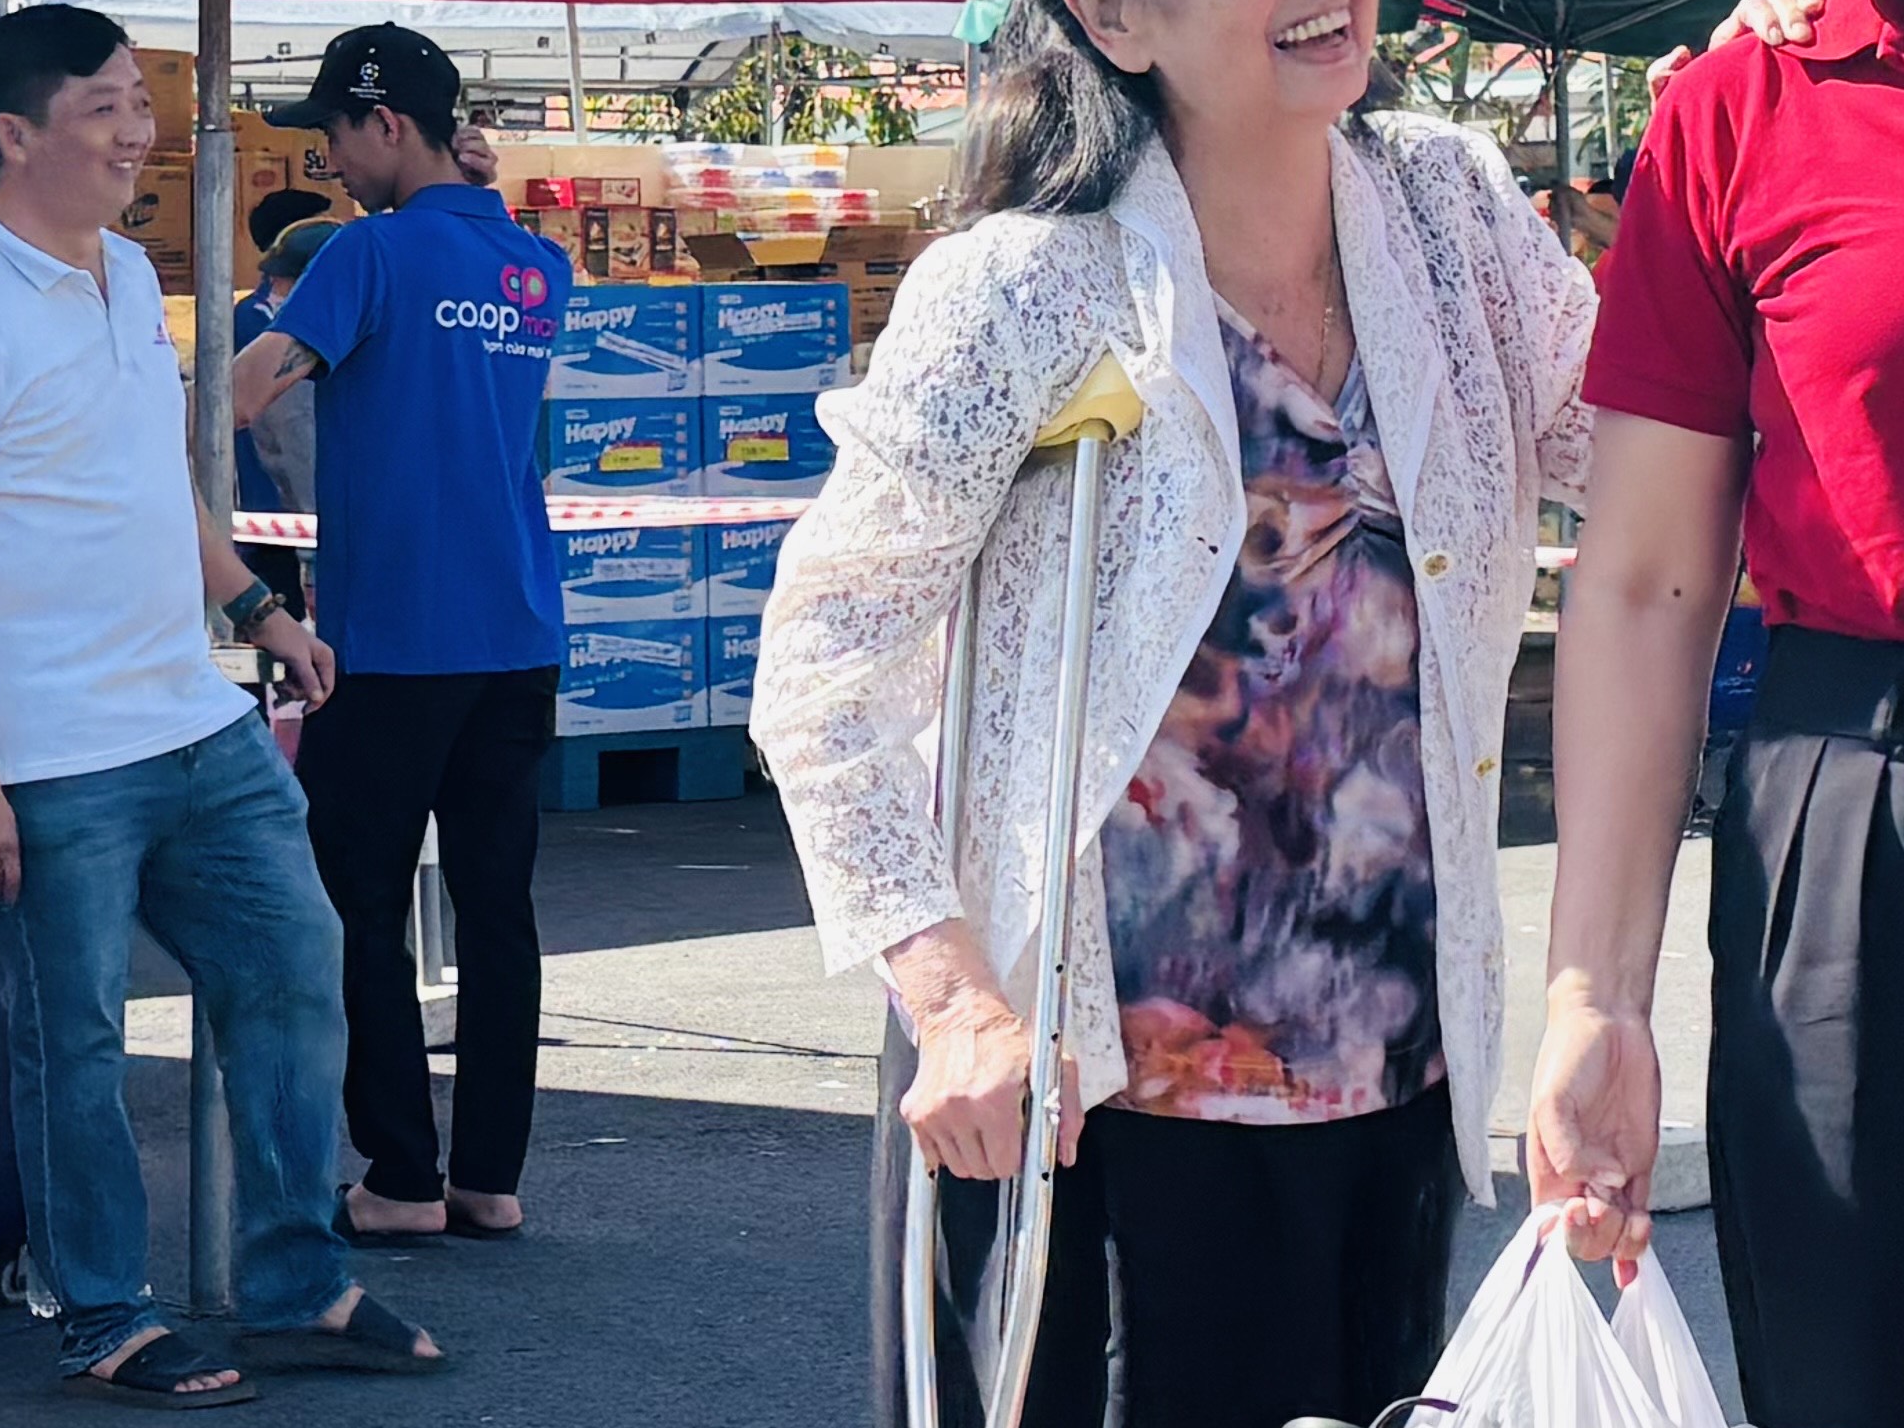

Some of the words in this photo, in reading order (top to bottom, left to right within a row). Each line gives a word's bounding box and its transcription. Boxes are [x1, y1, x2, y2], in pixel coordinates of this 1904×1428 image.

[564, 304, 637, 332] Happy
[564, 416, 637, 445] Happy
[568, 529, 641, 557] Happy
